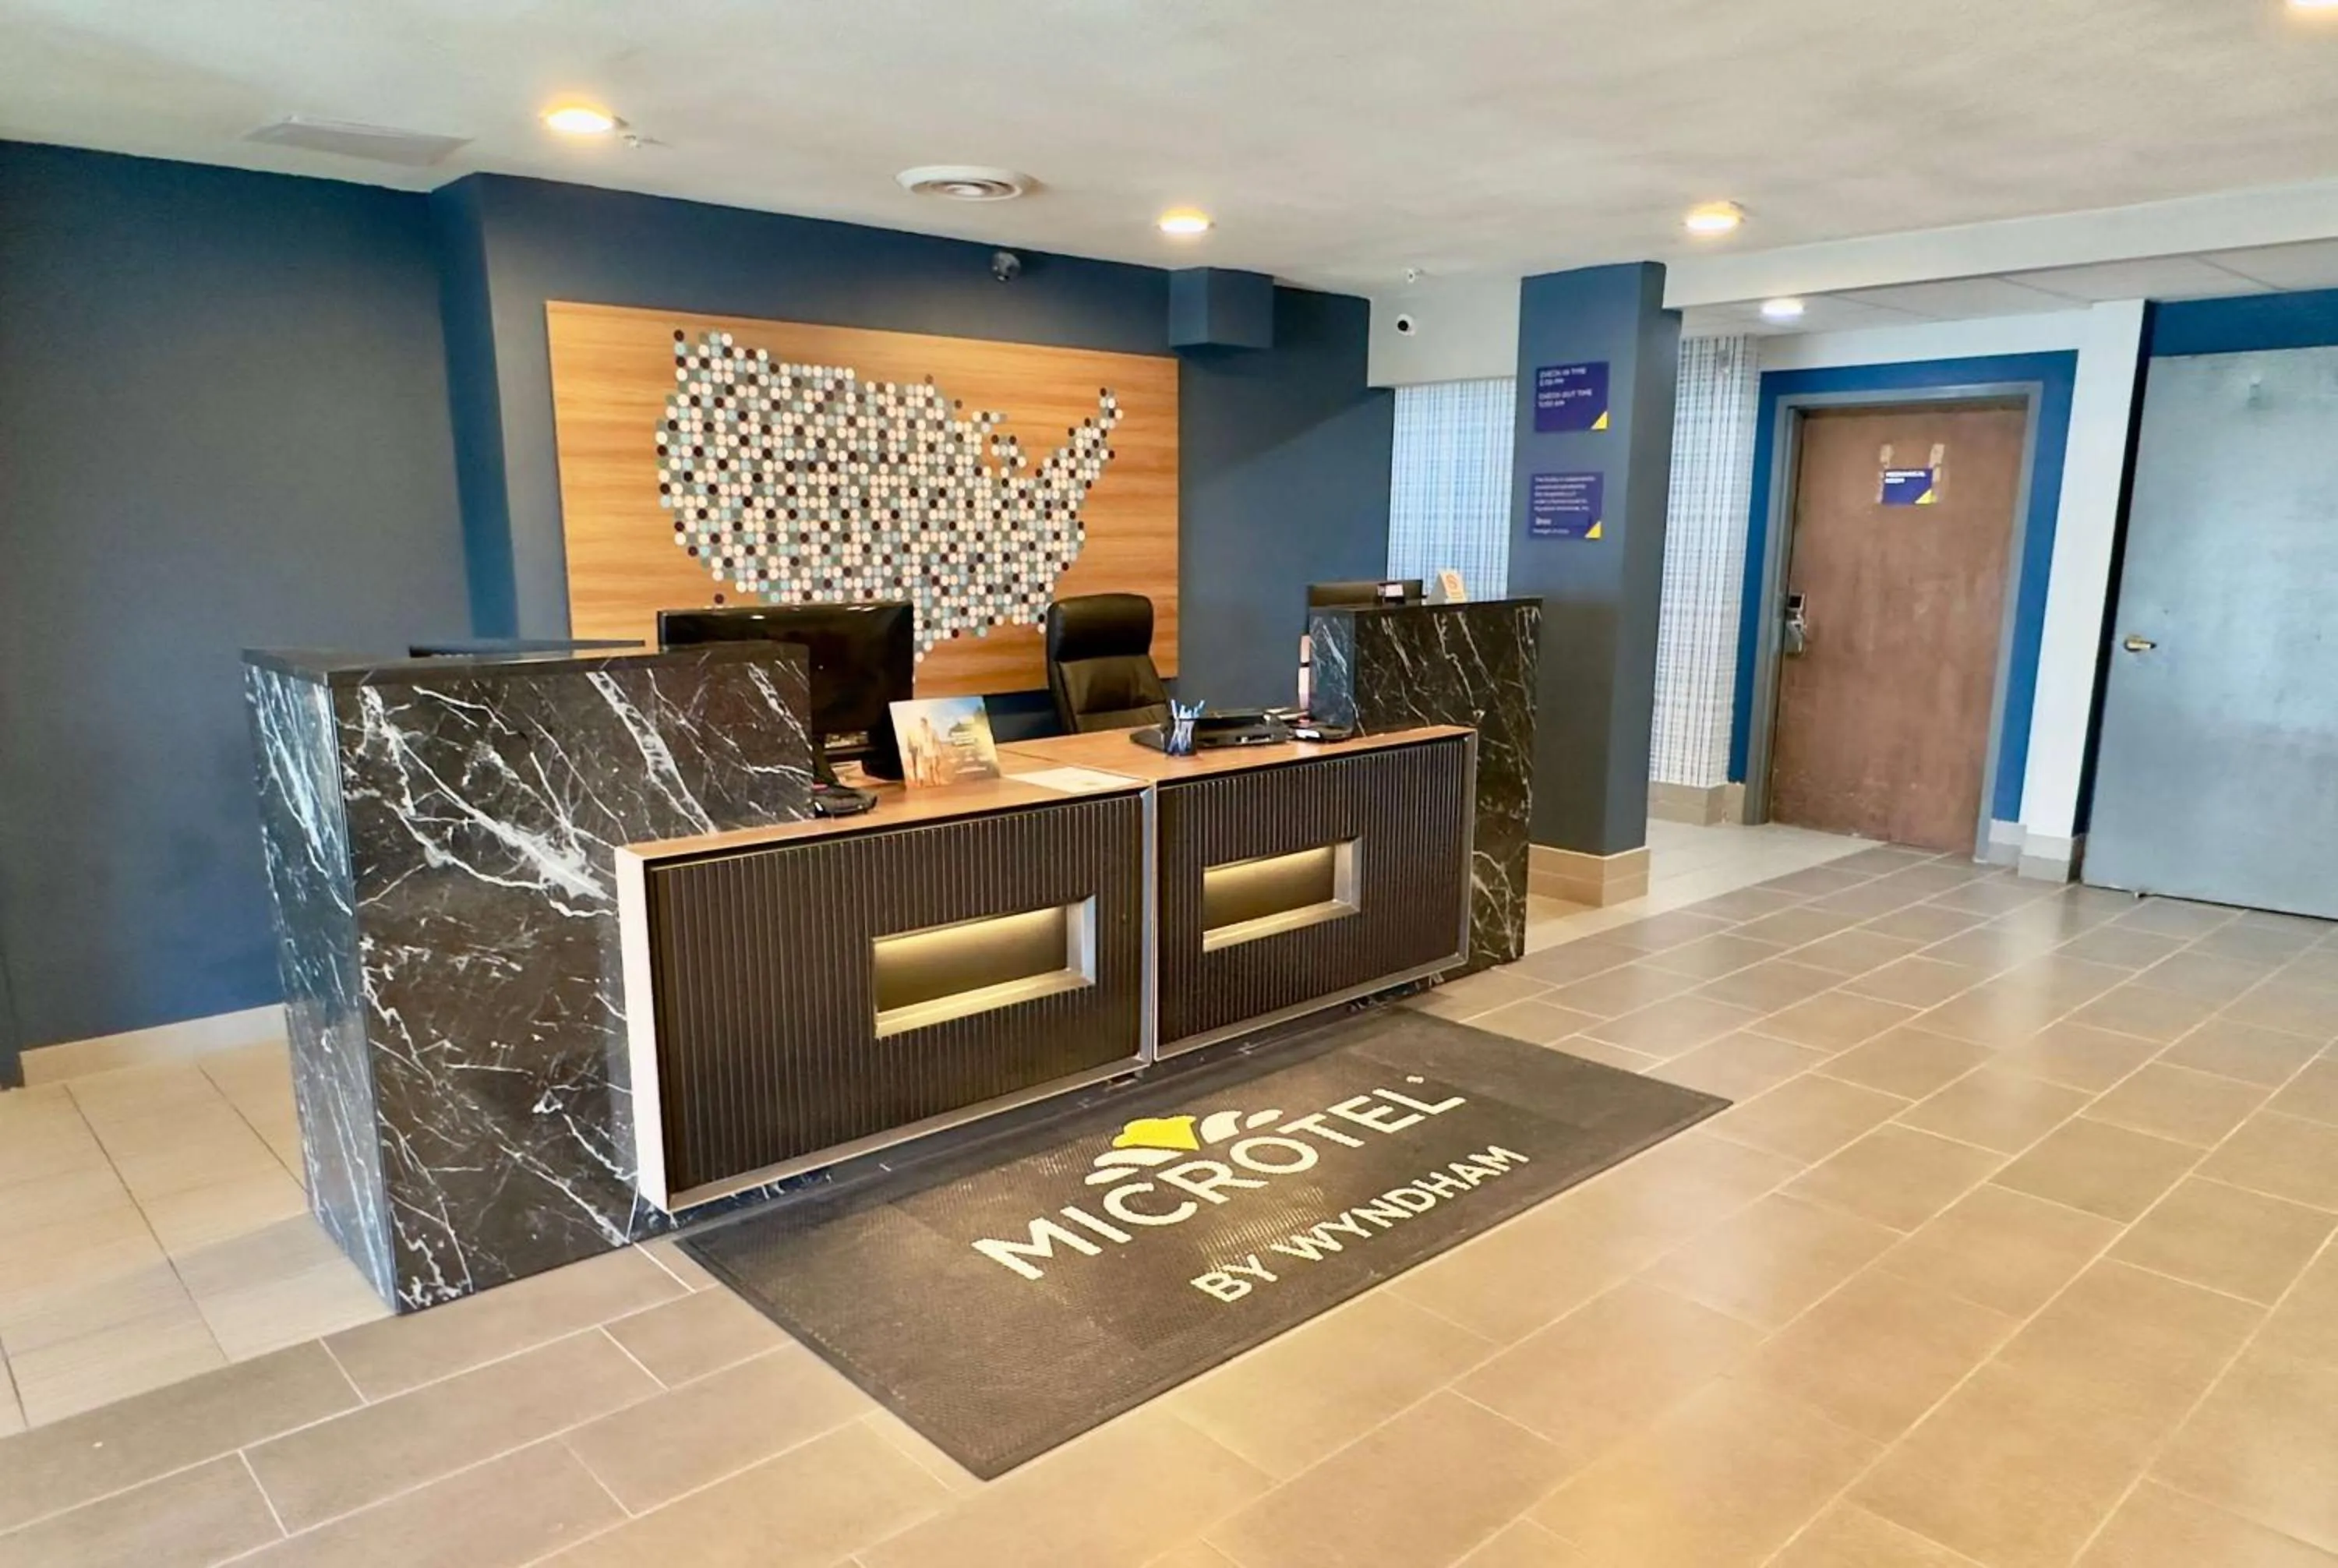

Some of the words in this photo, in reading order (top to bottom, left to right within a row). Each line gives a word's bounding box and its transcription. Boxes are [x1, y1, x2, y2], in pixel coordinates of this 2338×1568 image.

[971, 1089, 1467, 1280] MICROTEL
[1190, 1254, 1278, 1302] BY
[1270, 1142, 1530, 1262] WYNDHAM
